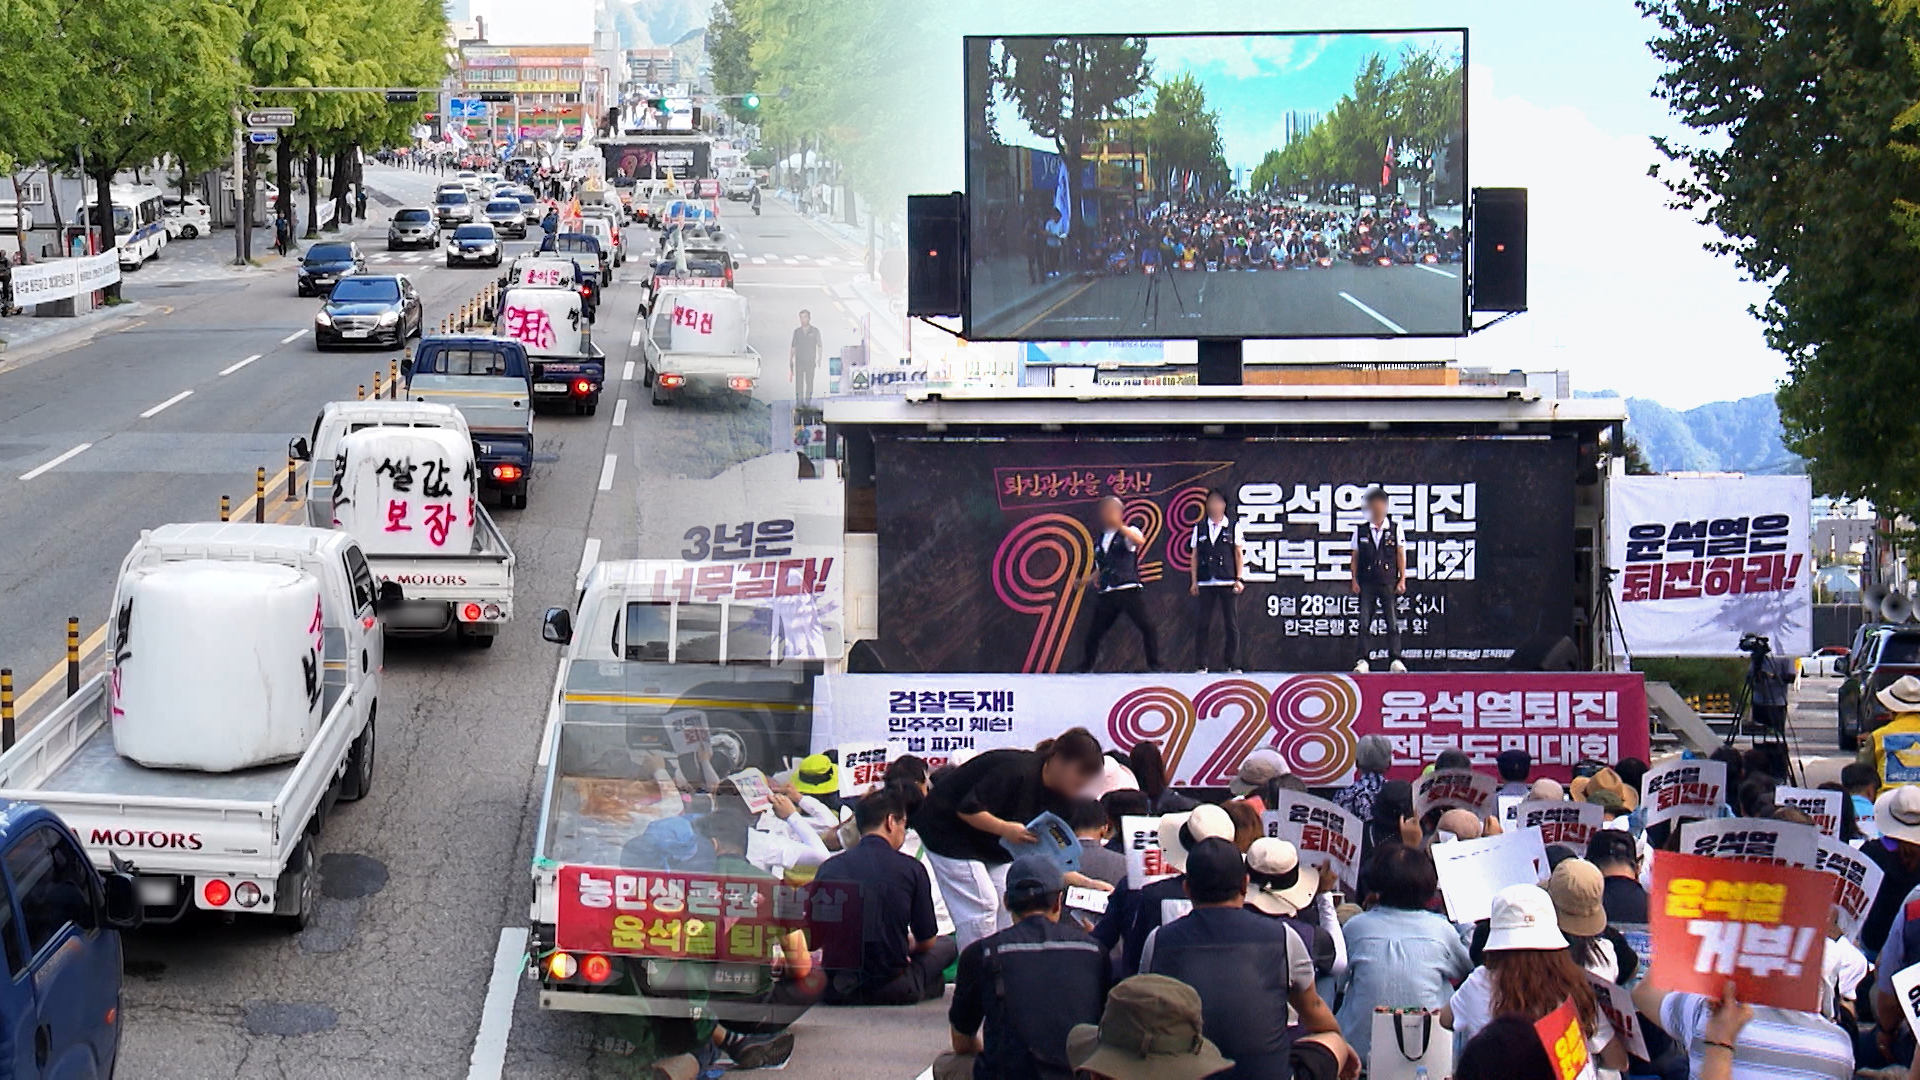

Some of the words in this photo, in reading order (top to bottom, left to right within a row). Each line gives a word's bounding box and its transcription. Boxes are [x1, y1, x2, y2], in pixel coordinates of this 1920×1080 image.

[1003, 472, 1100, 498] 퇴진광장을
[1106, 470, 1152, 497] 열자!
[385, 498, 456, 546] 보장
[1237, 482, 1477, 533] 윤석열퇴진
[681, 519, 794, 562] 3년은
[1626, 514, 1789, 562] 윤석열은
[1240, 538, 1477, 582] 전북도대회
[1622, 553, 1803, 602] 퇴진하라!
[397, 574, 467, 586] MOTORS
[1267, 595, 1296, 616] 9월
[1284, 618, 1345, 637] 한국은행
[888, 690, 1014, 713] 검찰독재!
[1381, 690, 1619, 729] 윤석열퇴진
[888, 716, 964, 732] 민주주의
[1390, 733, 1619, 767] 전북도민대회
[1648, 767, 1701, 795] 윤석열
[1656, 783, 1720, 812] 퇴진!
[1289, 803, 1345, 835] 윤석열
[91, 829, 203, 850] MOTORS
[1300, 824, 1357, 866] 퇴진!
[1693, 830, 1779, 857] 윤석열
[578, 872, 760, 918] 농민생존권
[1665, 878, 1788, 922] 윤석열
[612, 914, 717, 955] 윤석열
[1686, 919, 1818, 978] 거부!
